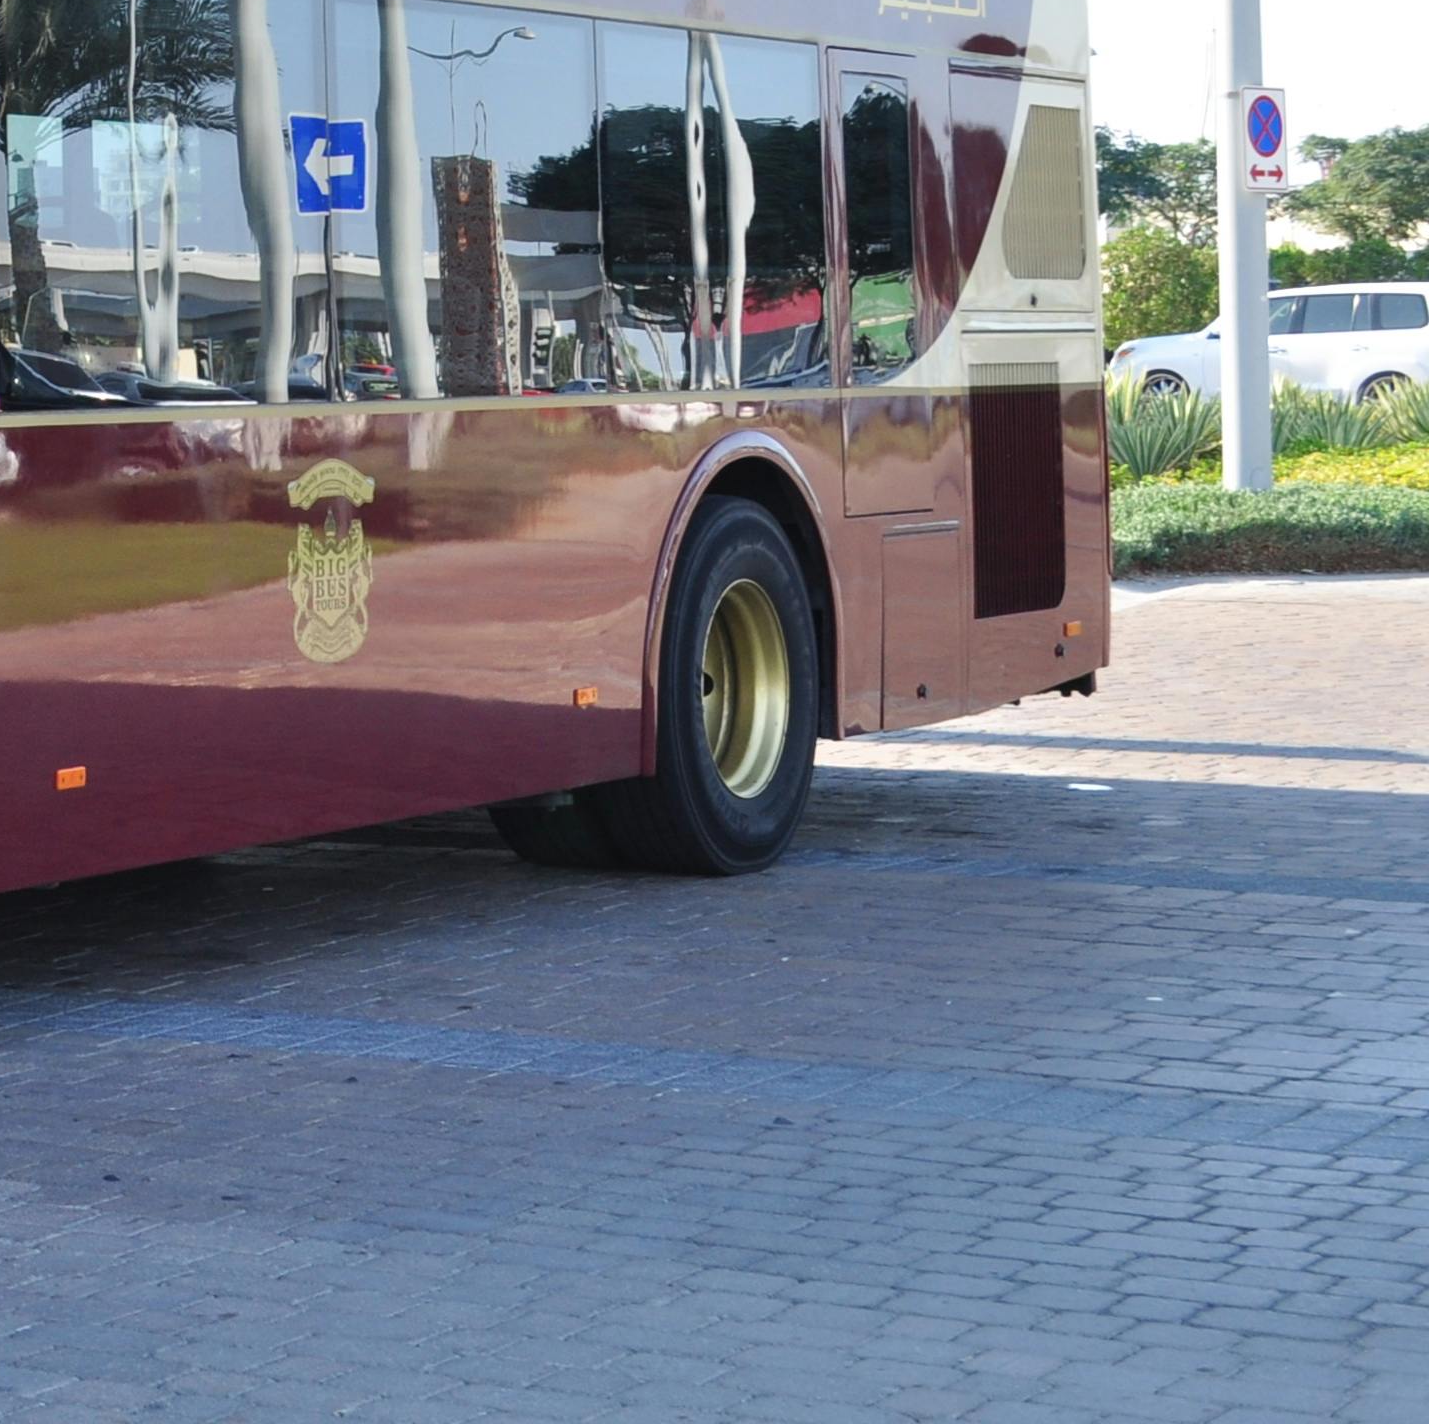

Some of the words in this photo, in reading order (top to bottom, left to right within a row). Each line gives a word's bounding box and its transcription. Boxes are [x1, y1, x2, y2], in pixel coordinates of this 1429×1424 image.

[315, 557, 346, 577] BIG
[315, 577, 347, 598] BUS
[315, 597, 347, 611] TOURS
